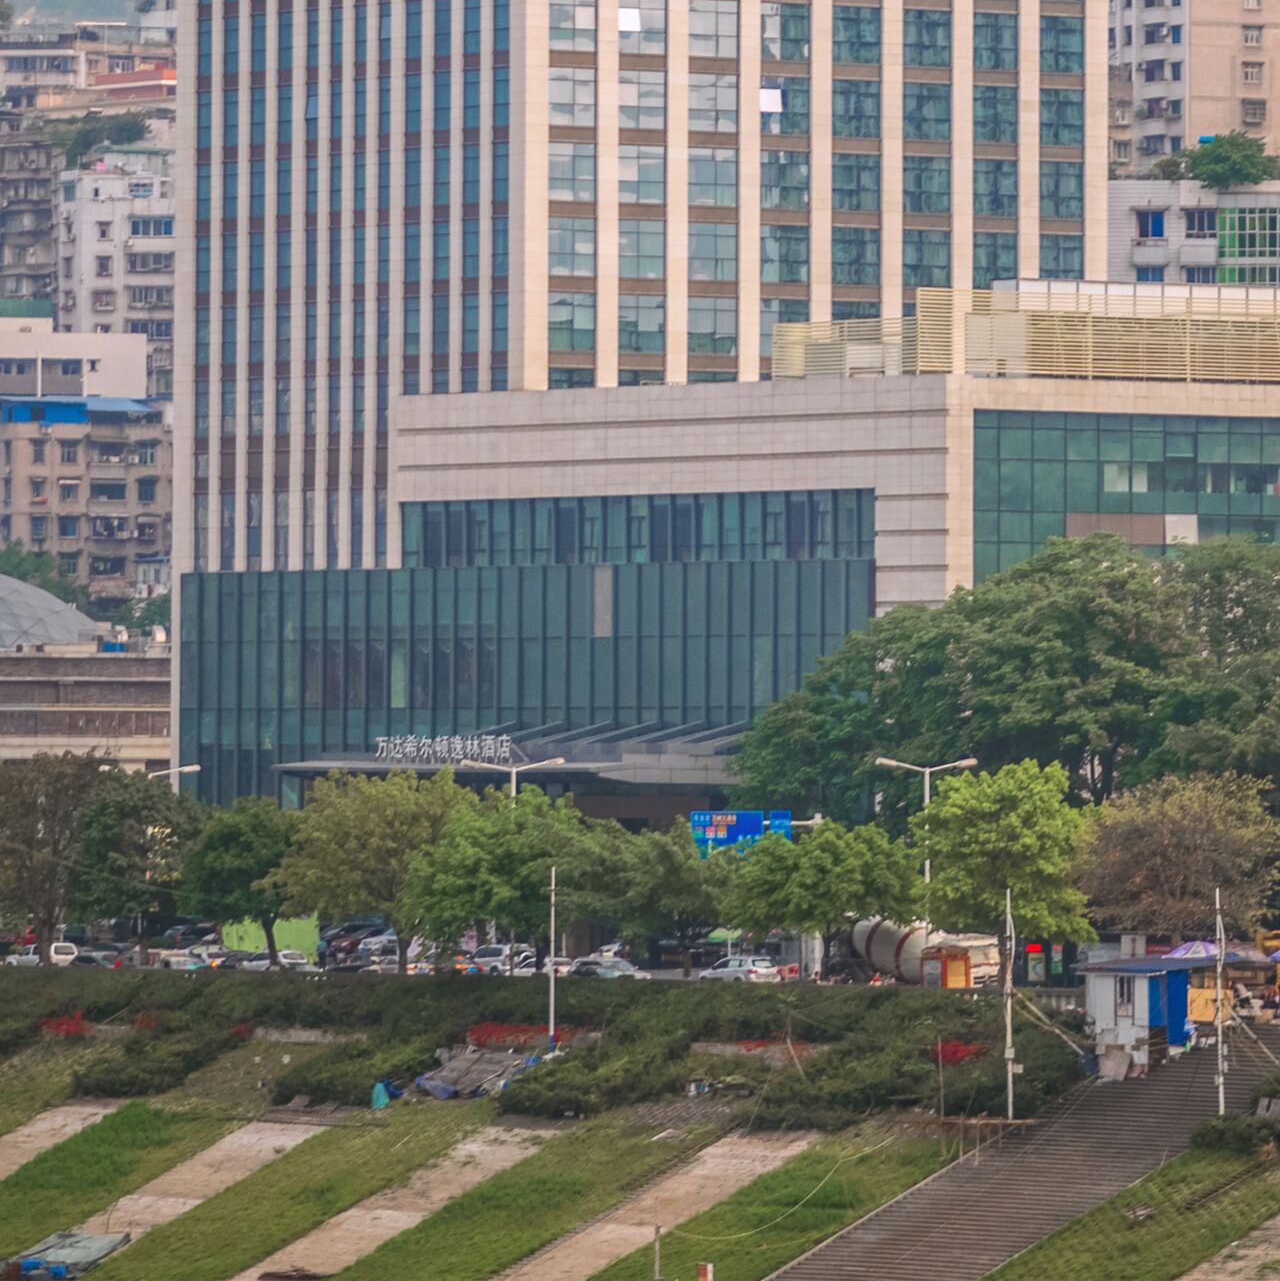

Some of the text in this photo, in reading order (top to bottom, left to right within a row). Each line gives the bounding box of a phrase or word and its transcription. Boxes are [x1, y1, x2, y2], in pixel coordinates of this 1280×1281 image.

[375, 734, 512, 759] 万达希尔顿逸林酒店
